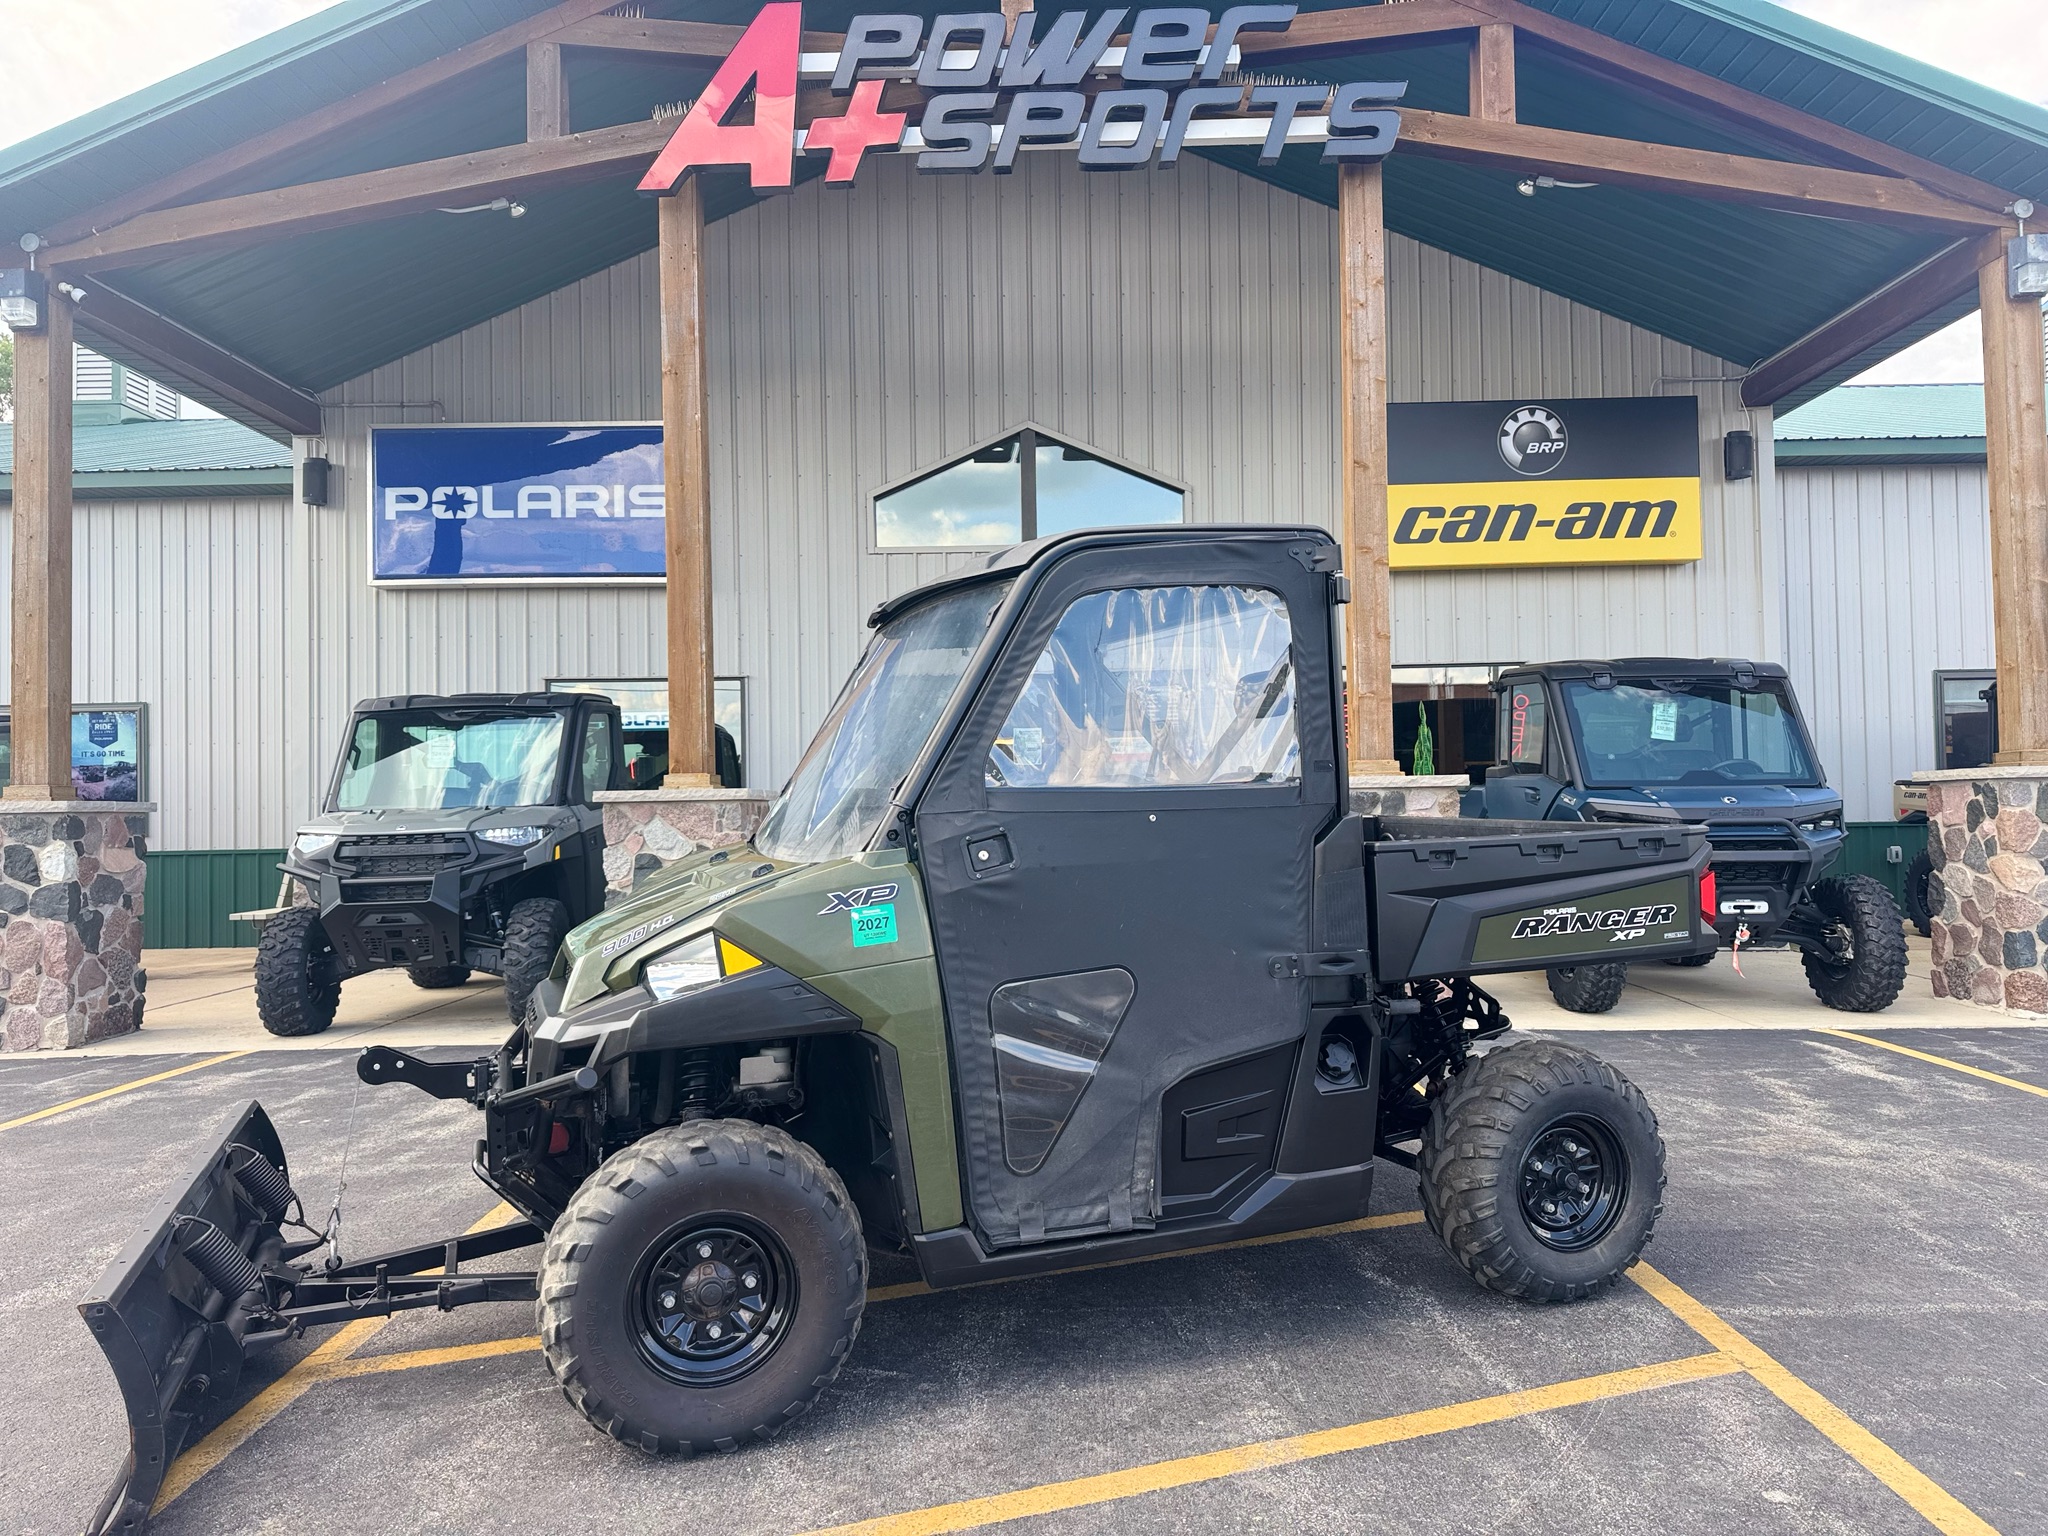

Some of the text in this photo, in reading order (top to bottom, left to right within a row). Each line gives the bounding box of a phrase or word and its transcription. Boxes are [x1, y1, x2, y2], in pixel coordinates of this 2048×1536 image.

[1525, 441, 1565, 454] BRP
[384, 484, 666, 520] POLARIS
[1393, 499, 1678, 545] can-am
[94, 723, 113, 731] RIDE
[81, 750, 95, 758] IT'S
[557, 814, 575, 826] XP
[816, 883, 899, 915] XP
[1543, 906, 1577, 916] POLARIS
[857, 916, 890, 932] 2027
[1511, 904, 1678, 939] RANGER
[601, 924, 648, 958] 900
[1608, 928, 1647, 943] XP
